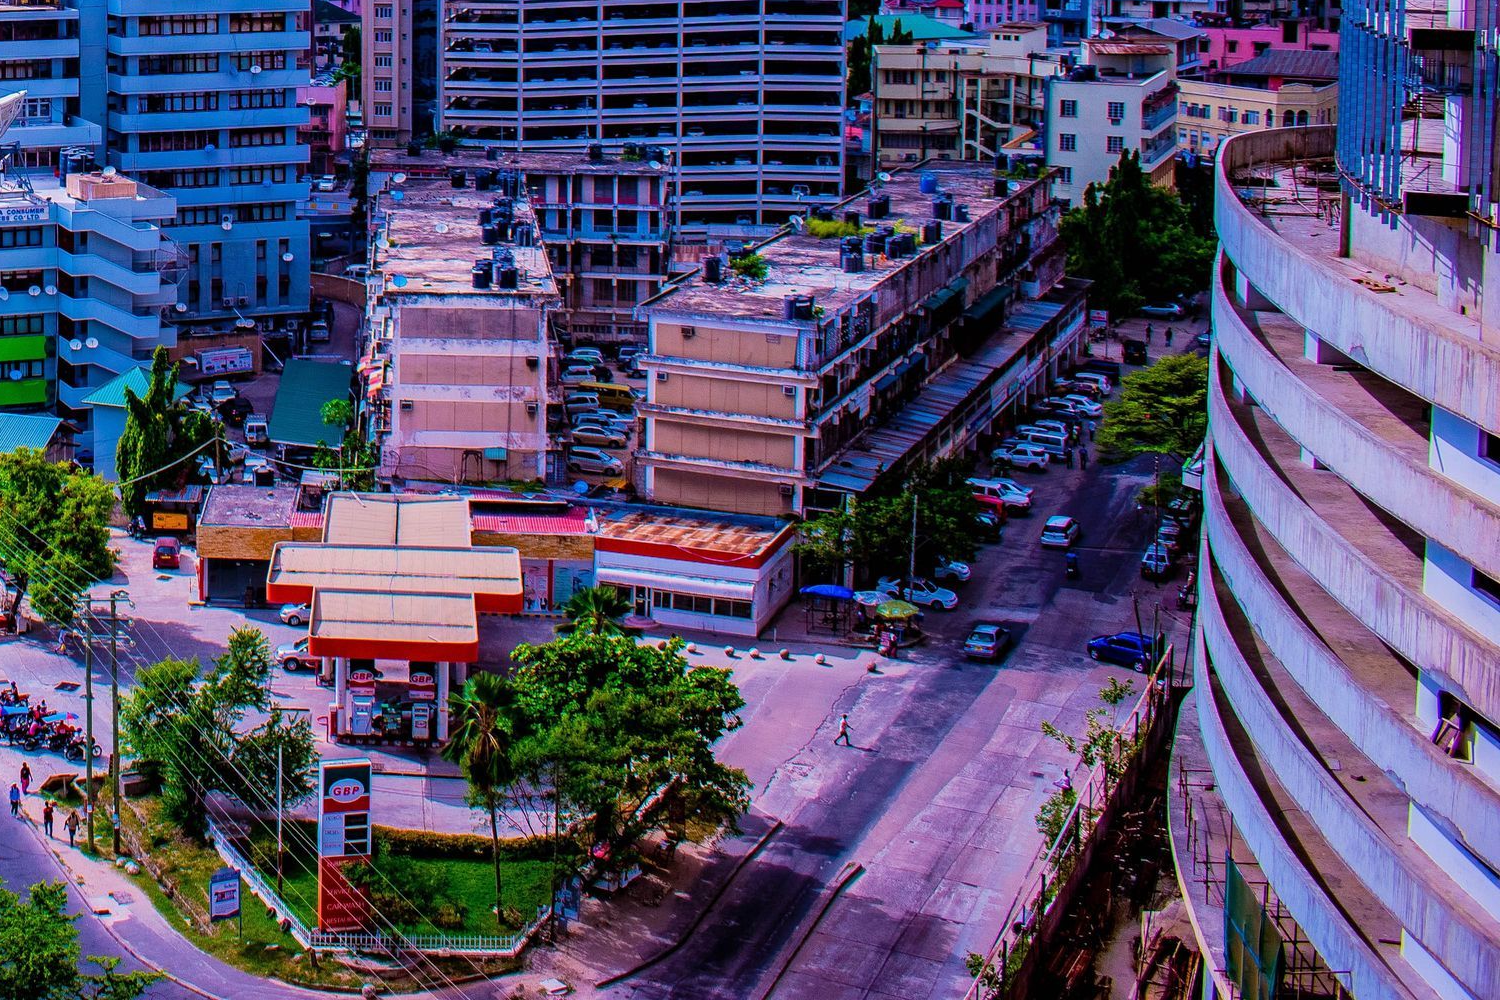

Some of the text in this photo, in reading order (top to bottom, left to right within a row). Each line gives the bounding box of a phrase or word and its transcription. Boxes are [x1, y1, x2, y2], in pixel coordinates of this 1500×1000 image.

[352, 672, 373, 681] GBP
[411, 675, 432, 684] GBP
[333, 786, 360, 796] GBP
